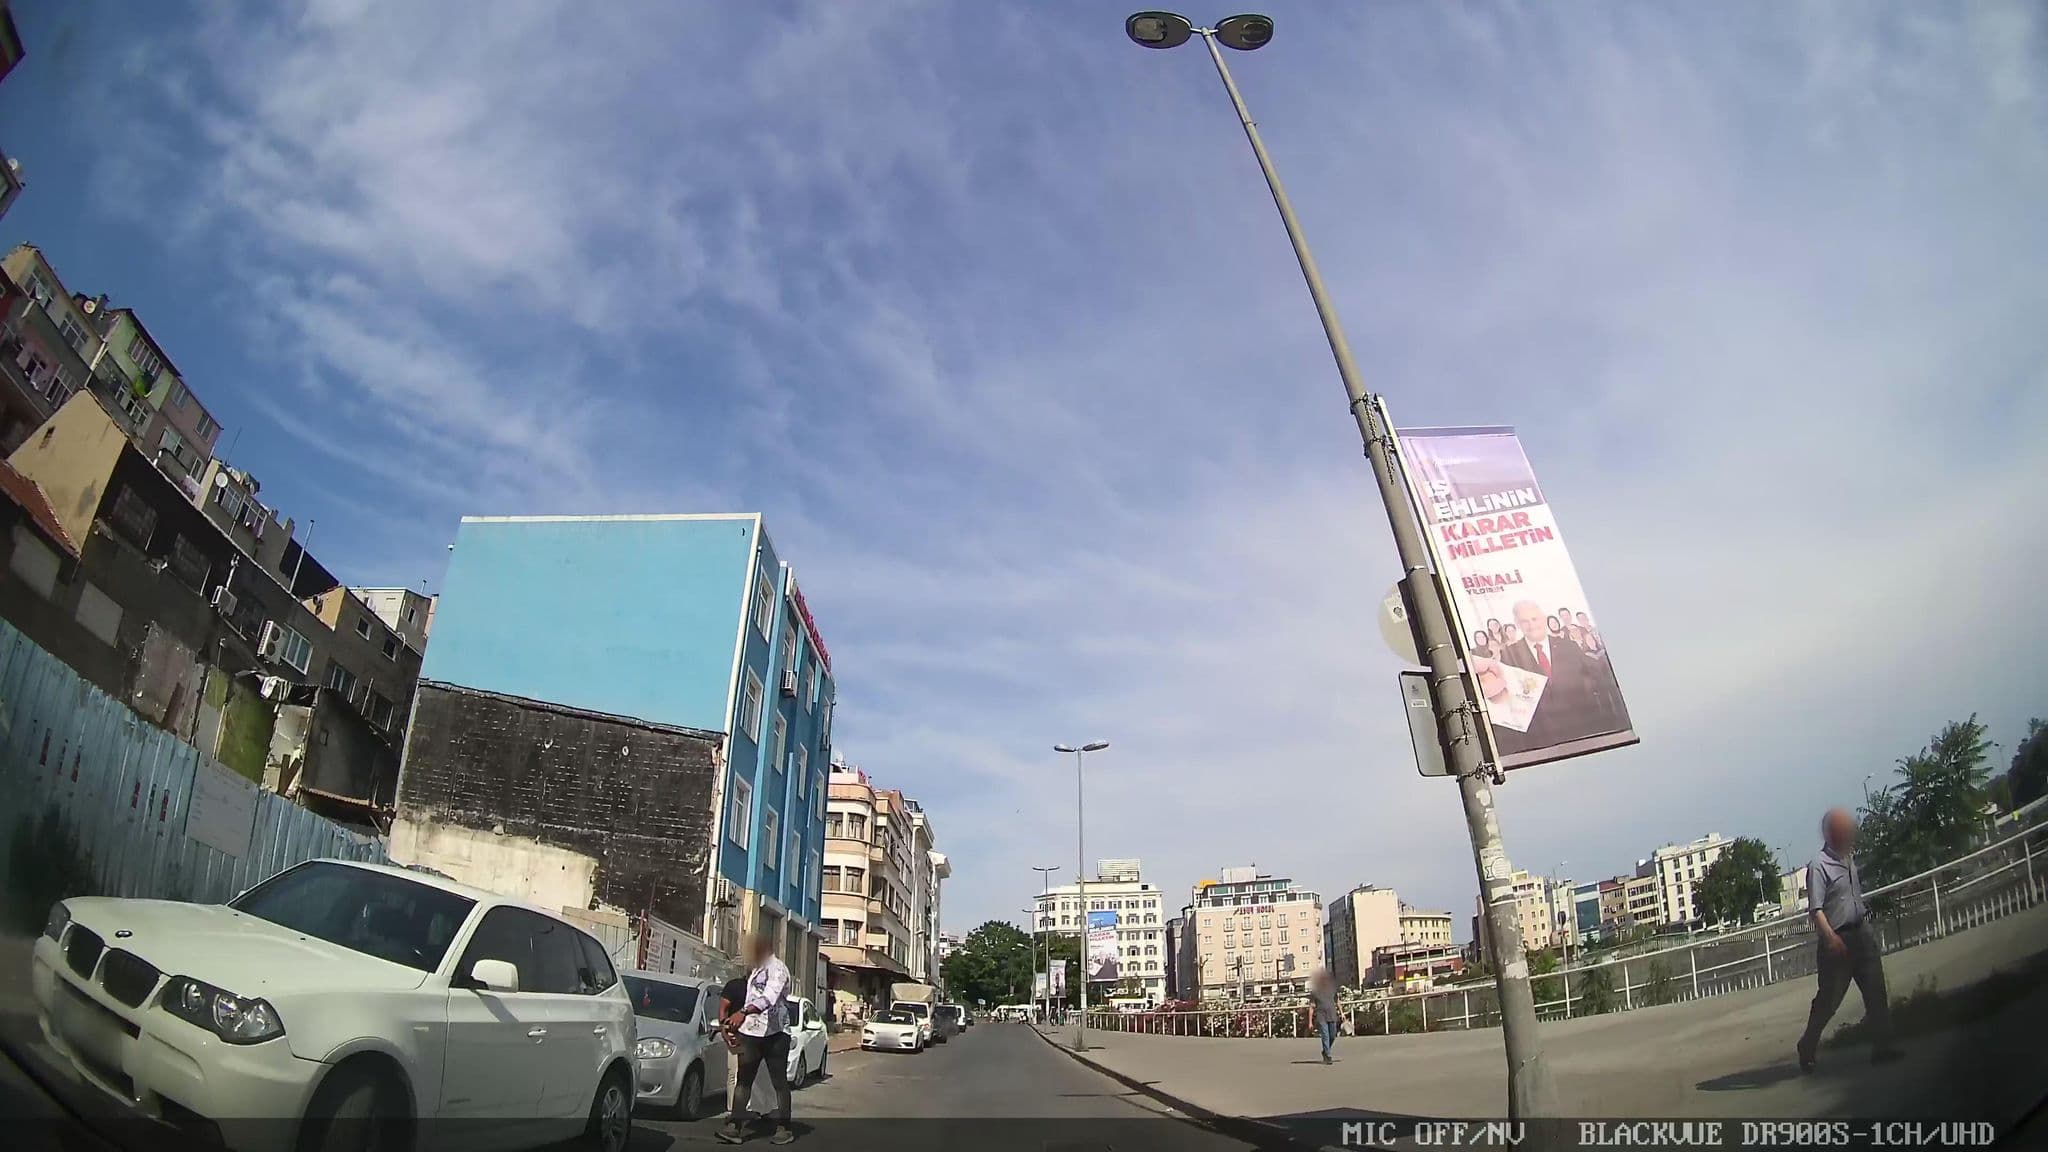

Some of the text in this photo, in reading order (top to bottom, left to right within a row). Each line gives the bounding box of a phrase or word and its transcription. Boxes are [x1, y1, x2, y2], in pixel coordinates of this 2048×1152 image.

[1433, 487, 1537, 520] EHLİNİN
[1441, 511, 1532, 542] KARAR
[1447, 526, 1554, 560] MİLLETİN
[1461, 569, 1523, 588] BİNALİ
